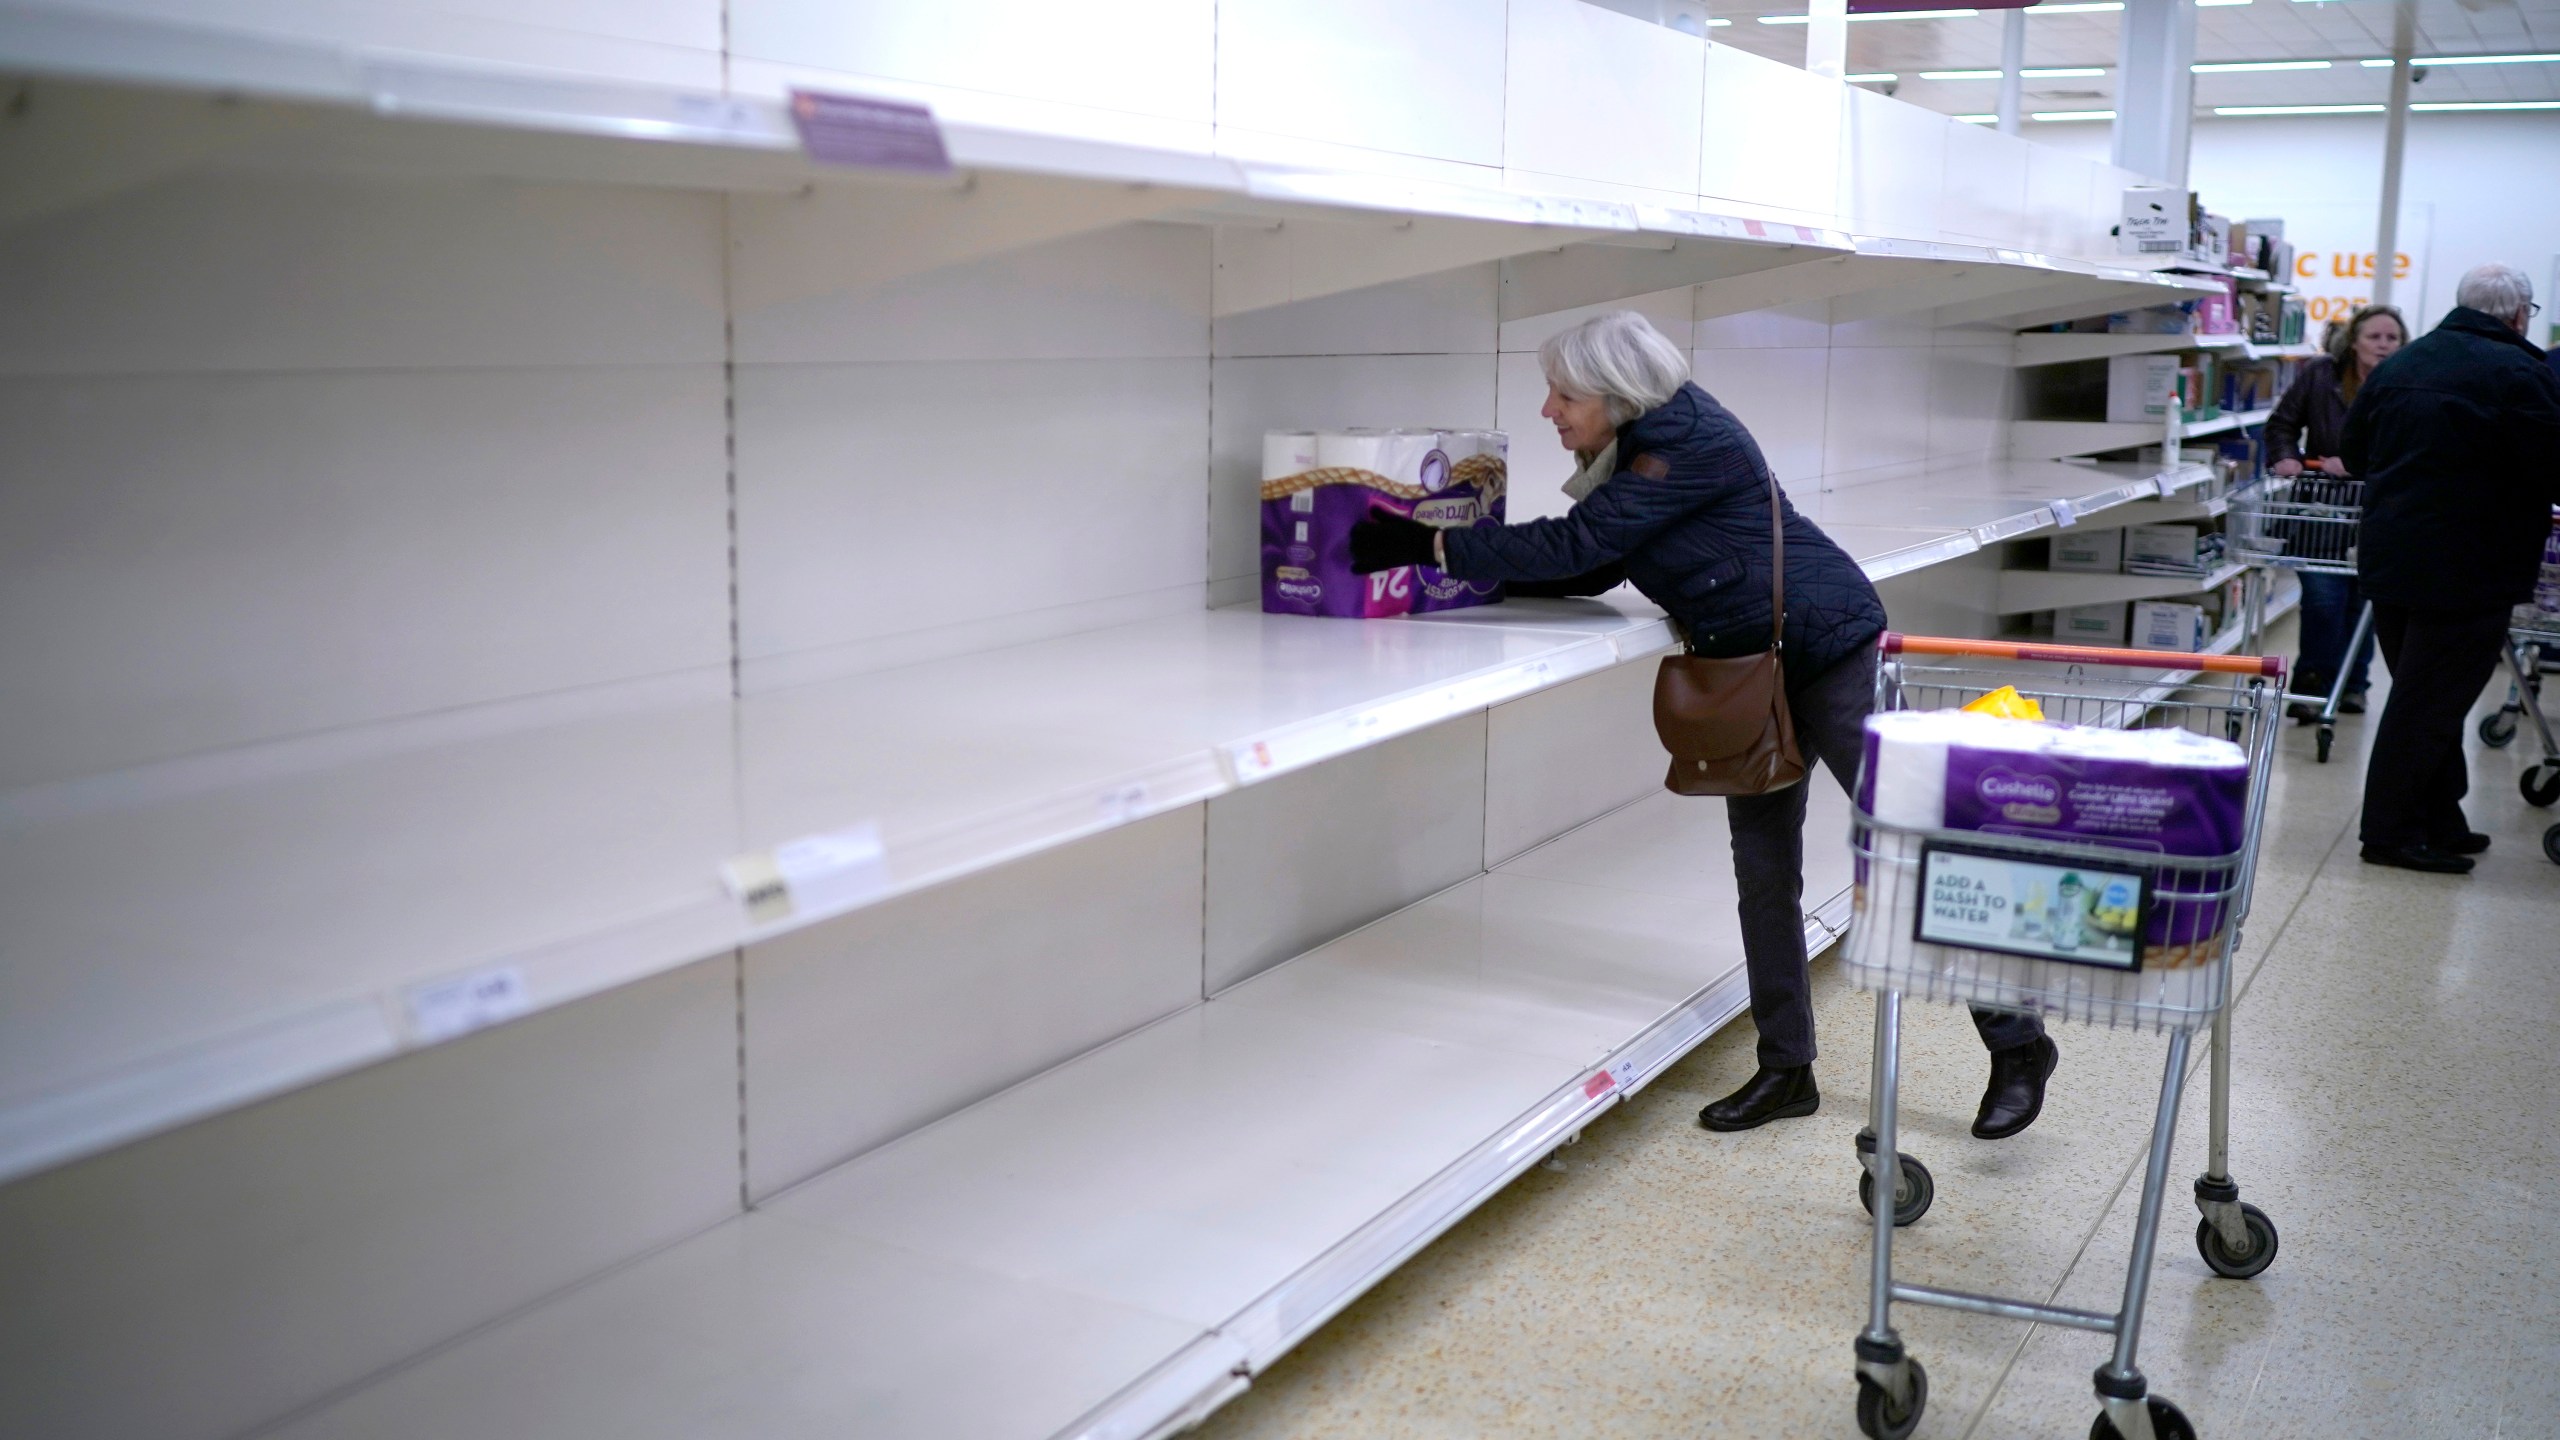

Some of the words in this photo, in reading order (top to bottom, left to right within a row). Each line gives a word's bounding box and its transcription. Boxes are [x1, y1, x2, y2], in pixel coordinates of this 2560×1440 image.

[1446, 502, 1477, 521] Ultra
[1370, 565, 1408, 601] 24
[1424, 583, 1458, 599] SOFTEST
[1982, 776, 2056, 802] Cushelle
[1935, 874, 1970, 889] ADD
[1975, 881, 1986, 892] A
[1933, 888, 1979, 907] DASH
[1983, 895, 2006, 910] TO
[1933, 904, 1990, 924] WATER
